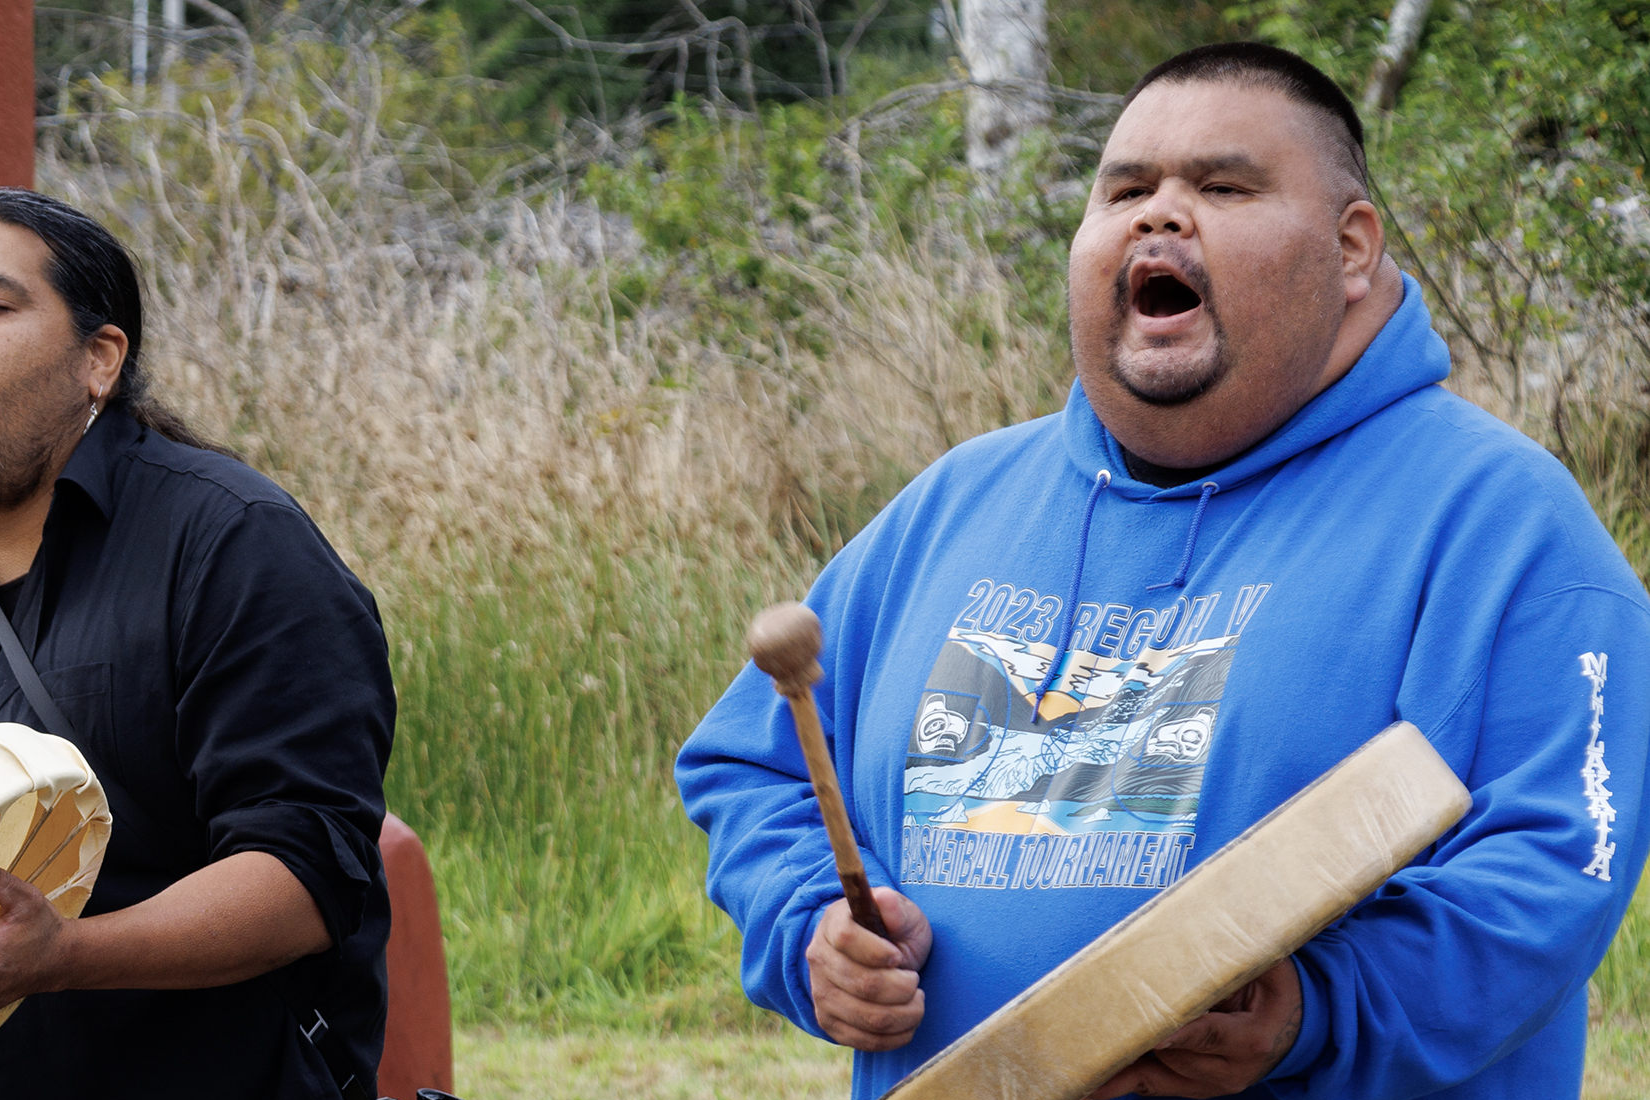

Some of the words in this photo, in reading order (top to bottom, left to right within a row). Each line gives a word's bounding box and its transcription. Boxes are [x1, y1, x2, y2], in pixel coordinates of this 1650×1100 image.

[953, 577, 1064, 644] 2023
[1065, 591, 1223, 662] REGON
[1224, 583, 1273, 638] V
[901, 824, 1016, 890] BASKETBALL
[1011, 830, 1197, 890] TOURNAMENT
